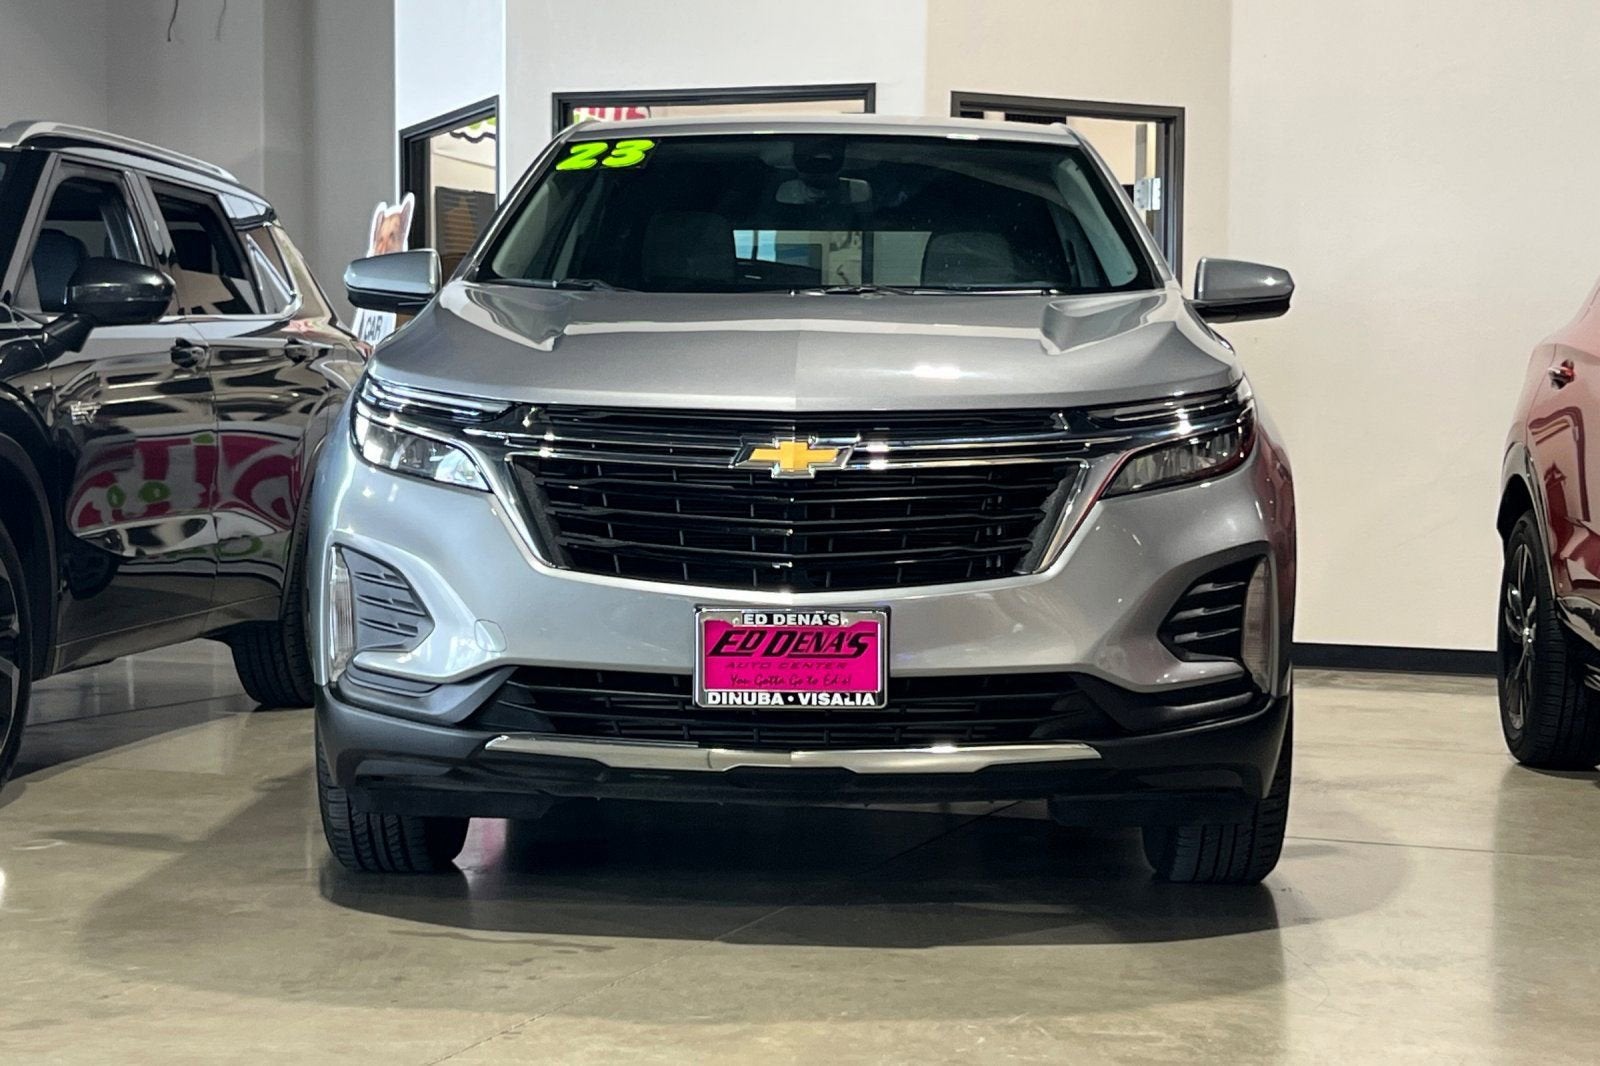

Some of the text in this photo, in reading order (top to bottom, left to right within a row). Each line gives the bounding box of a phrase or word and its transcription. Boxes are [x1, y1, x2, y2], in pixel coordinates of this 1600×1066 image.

[555, 139, 655, 171] 23
[743, 613, 840, 625] ED DENA'S
[707, 629, 878, 658] ED DENA'S
[726, 661, 848, 670] AUTO CENTER
[731, 673, 749, 687] You
[754, 673, 785, 687] Gotta
[789, 674, 803, 687] Go
[807, 675, 818, 685] to
[708, 692, 876, 706] DINUBA VISALIA
